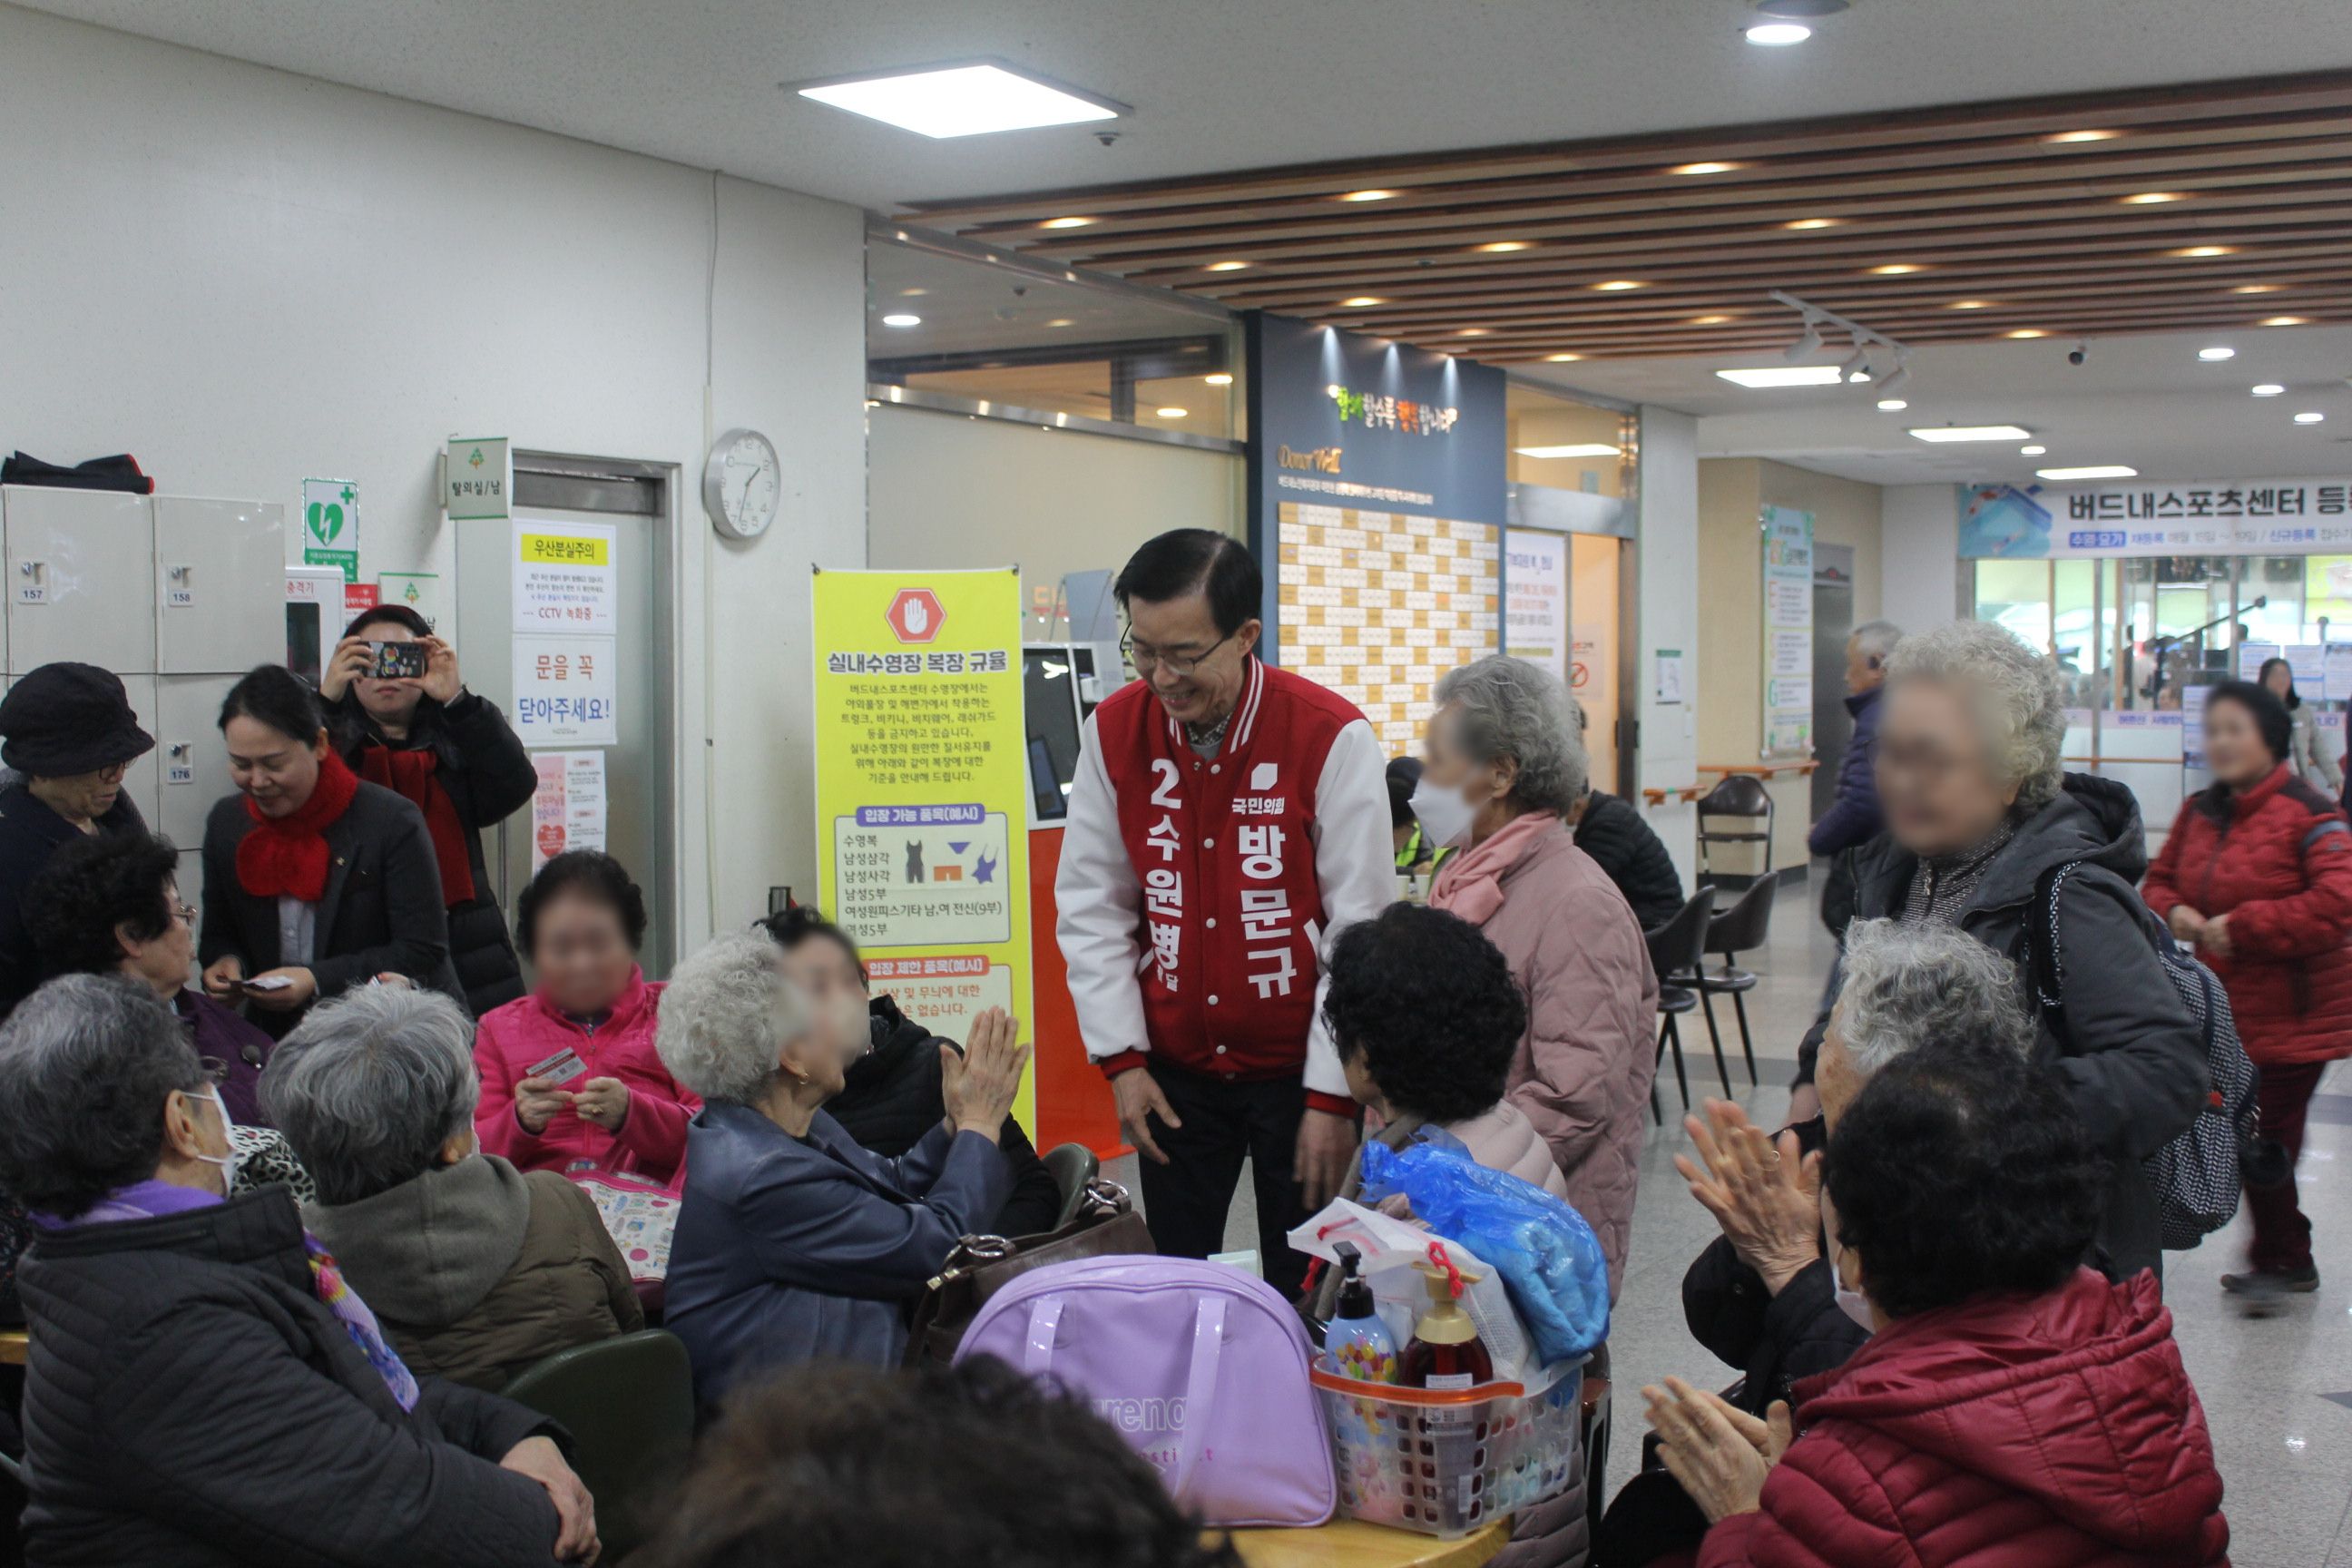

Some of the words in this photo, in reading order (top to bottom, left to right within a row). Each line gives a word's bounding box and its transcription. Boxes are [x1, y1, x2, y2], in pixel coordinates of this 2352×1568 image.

[452, 479, 500, 496] 탈의실/남
[2070, 487, 2305, 522] 버드내스포츠센터
[2317, 486, 2352, 516] 등
[534, 539, 595, 560] 우산분실주의
[24, 590, 43, 600] 157
[173, 593, 191, 603] 158
[538, 607, 562, 619] CCTV
[567, 607, 593, 621] 녹화중
[535, 654, 569, 681] 문을
[578, 654, 593, 681] 꼭
[828, 652, 922, 673] 실내수영장
[926, 652, 965, 673] 복장
[969, 651, 1007, 671] 규율
[849, 684, 927, 695] 버드내스포츠센터
[930, 682, 988, 694] 수영장에서는
[519, 697, 610, 723] 닫아주세요!
[887, 700, 897, 710] 및
[900, 699, 948, 710] 해변가에서
[952, 698, 990, 709] 착용하는
[867, 730, 886, 740] 등을
[890, 729, 928, 740] 금지하고
[932, 728, 974, 739] 있습니다.
[850, 744, 907, 755] 실내수영장의
[911, 743, 939, 754] 원만한
[944, 742, 991, 753] 질서유지를
[856, 758, 875, 769] 위해
[877, 758, 906, 769] 아래와
[910, 758, 929, 769] 같이
[933, 757, 961, 768] 복장에
[965, 756, 985, 767] 대한
[171, 770, 190, 780] 176
[868, 773, 897, 784] 기준을
[900, 772, 929, 784] 안내해
[933, 771, 975, 782] 드립니다.
[1151, 759, 1181, 809] 2
[1231, 797, 1285, 816] 국민의힘
[865, 809, 890, 823] 입장
[893, 808, 917, 822] 가능
[920, 807, 979, 822] 품목(예시)
[843, 835, 878, 848] 수영복
[844, 852, 890, 865] 남성삼각
[845, 869, 891, 883] 남성사각
[845, 888, 887, 901] 남성5부
[1145, 814, 1183, 971] 수원병
[845, 905, 921, 919] 여성원피스기타
[953, 901, 1003, 916] 전신(9부)
[1238, 824, 1297, 1000] 방문규
[869, 962, 894, 975] 입장
[897, 961, 922, 975] 제한
[904, 986, 915, 1000] 및
[919, 985, 954, 998] 무늬에
[957, 985, 980, 996] 대한
[917, 1004, 967, 1017] 없습니다.
